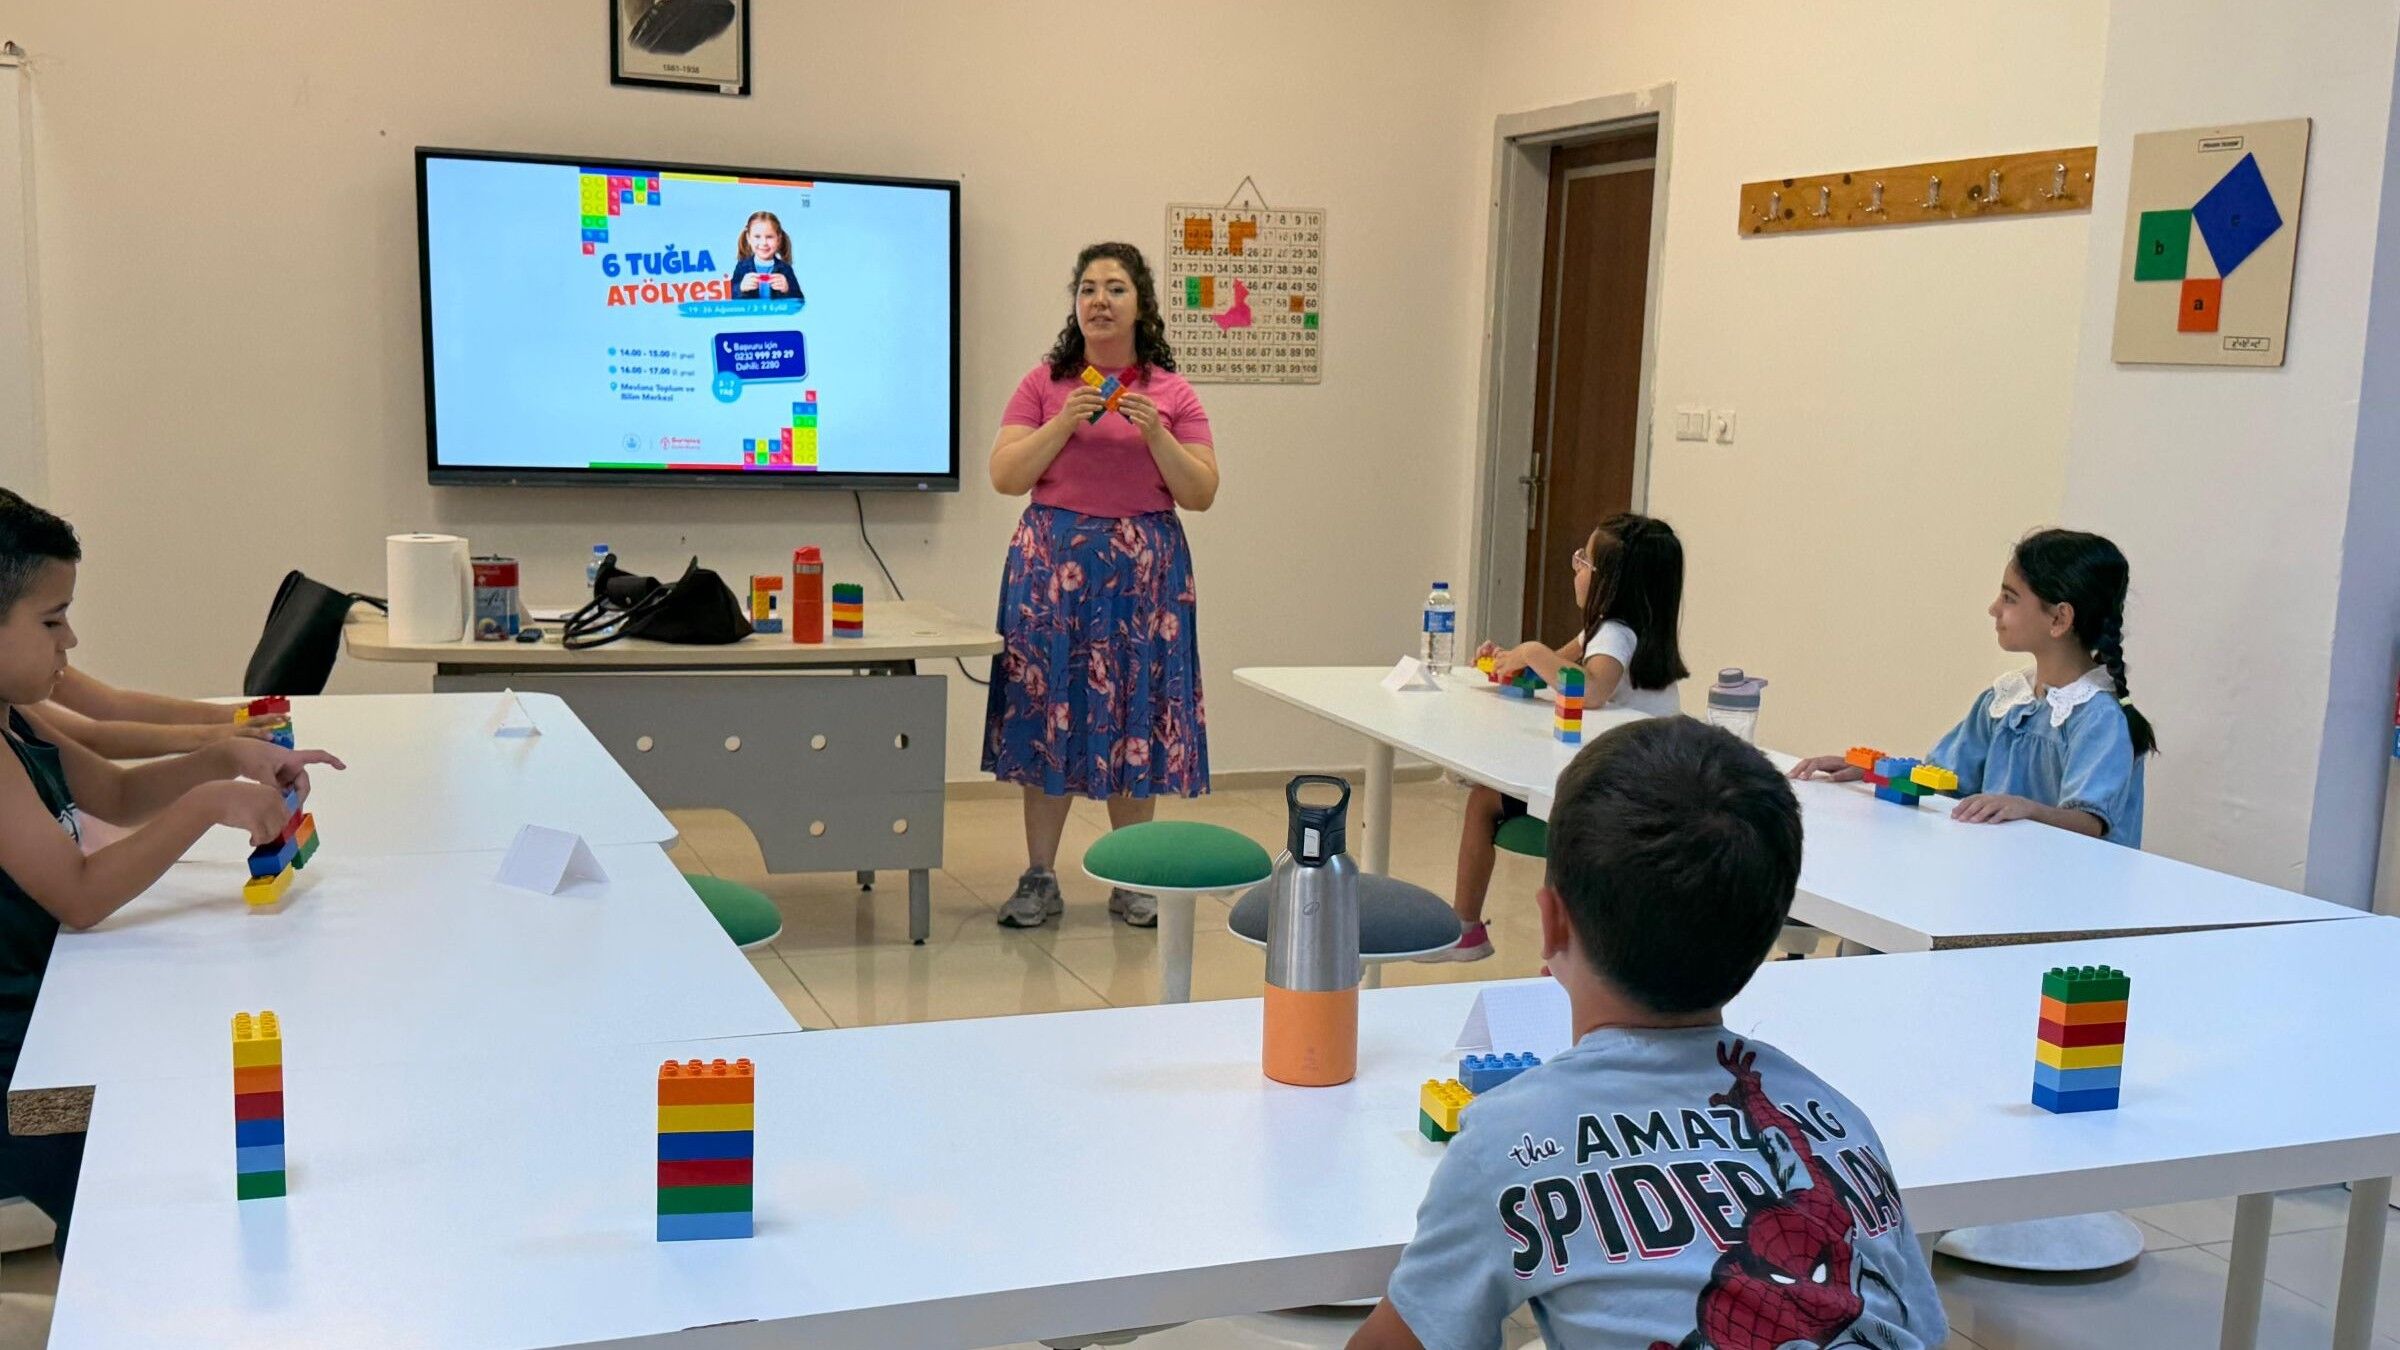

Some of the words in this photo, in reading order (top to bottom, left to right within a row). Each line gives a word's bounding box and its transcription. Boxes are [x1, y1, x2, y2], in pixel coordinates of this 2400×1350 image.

[1280, 215, 1286, 225] 8
[1296, 215, 1301, 225] 9
[1308, 216, 1318, 225] 10
[1174, 230, 1183, 238] 11
[1293, 232, 1303, 242] 19
[1307, 232, 1318, 242] 20
[1173, 246, 1183, 255] 21
[1217, 247, 1228, 256] 24
[1307, 249, 1318, 259] 30
[2154, 240, 2164, 256] b
[602, 254, 620, 278] 6
[626, 244, 716, 276] TUĞLA
[1172, 263, 1183, 272] 31
[1217, 264, 1228, 273] 34
[1232, 264, 1243, 274] 35
[1247, 264, 1258, 274] 36
[1262, 265, 1273, 274] 37
[1277, 265, 1288, 275] 38
[1292, 266, 1303, 276] 39
[1306, 266, 1318, 276] 40
[1172, 280, 1182, 289] 41
[1262, 282, 1273, 290] 47
[1276, 282, 1288, 291] 48
[1291, 282, 1302, 292] 49
[1306, 282, 1317, 292] 50
[1172, 296, 1182, 306] 51
[2194, 299, 2204, 311] a
[1172, 314, 1182, 323] 61
[1171, 330, 1182, 339] 71
[1186, 330, 1198, 340] 72
[1246, 331, 1257, 340] 76
[1261, 331, 1272, 340] 77
[1275, 331, 1287, 341] 78
[1290, 331, 1301, 341] 79
[1186, 347, 1197, 356] 82
[1201, 347, 1212, 357] 83
[1186, 364, 1198, 373] 92
[1508, 1133, 1563, 1168] the
